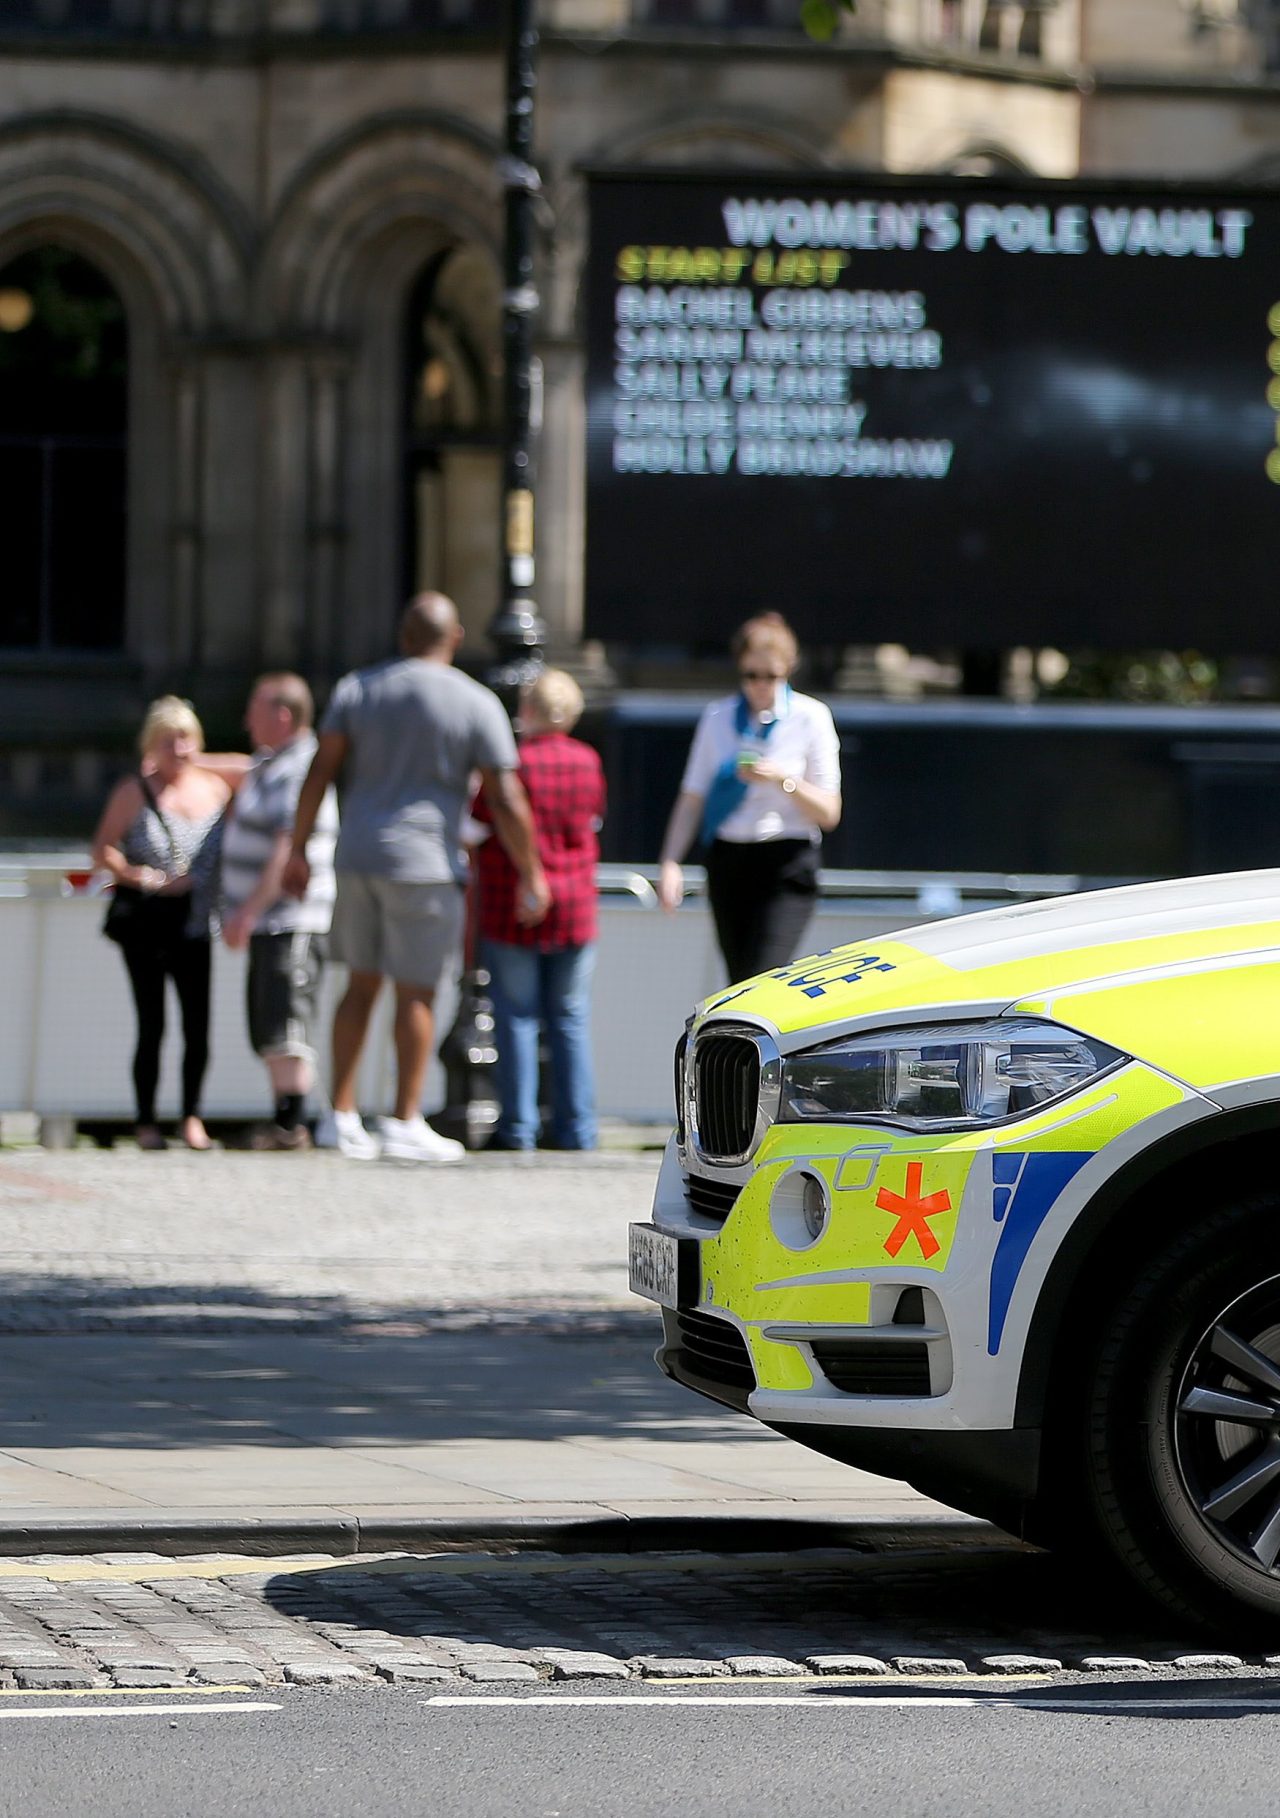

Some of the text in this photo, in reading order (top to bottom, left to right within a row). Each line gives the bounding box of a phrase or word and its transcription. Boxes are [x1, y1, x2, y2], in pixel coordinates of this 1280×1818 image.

[721, 197, 1253, 258] WOMEN'S POLE VAULT
[615, 245, 850, 287] START LIST
[615, 285, 755, 329] RACHEL
